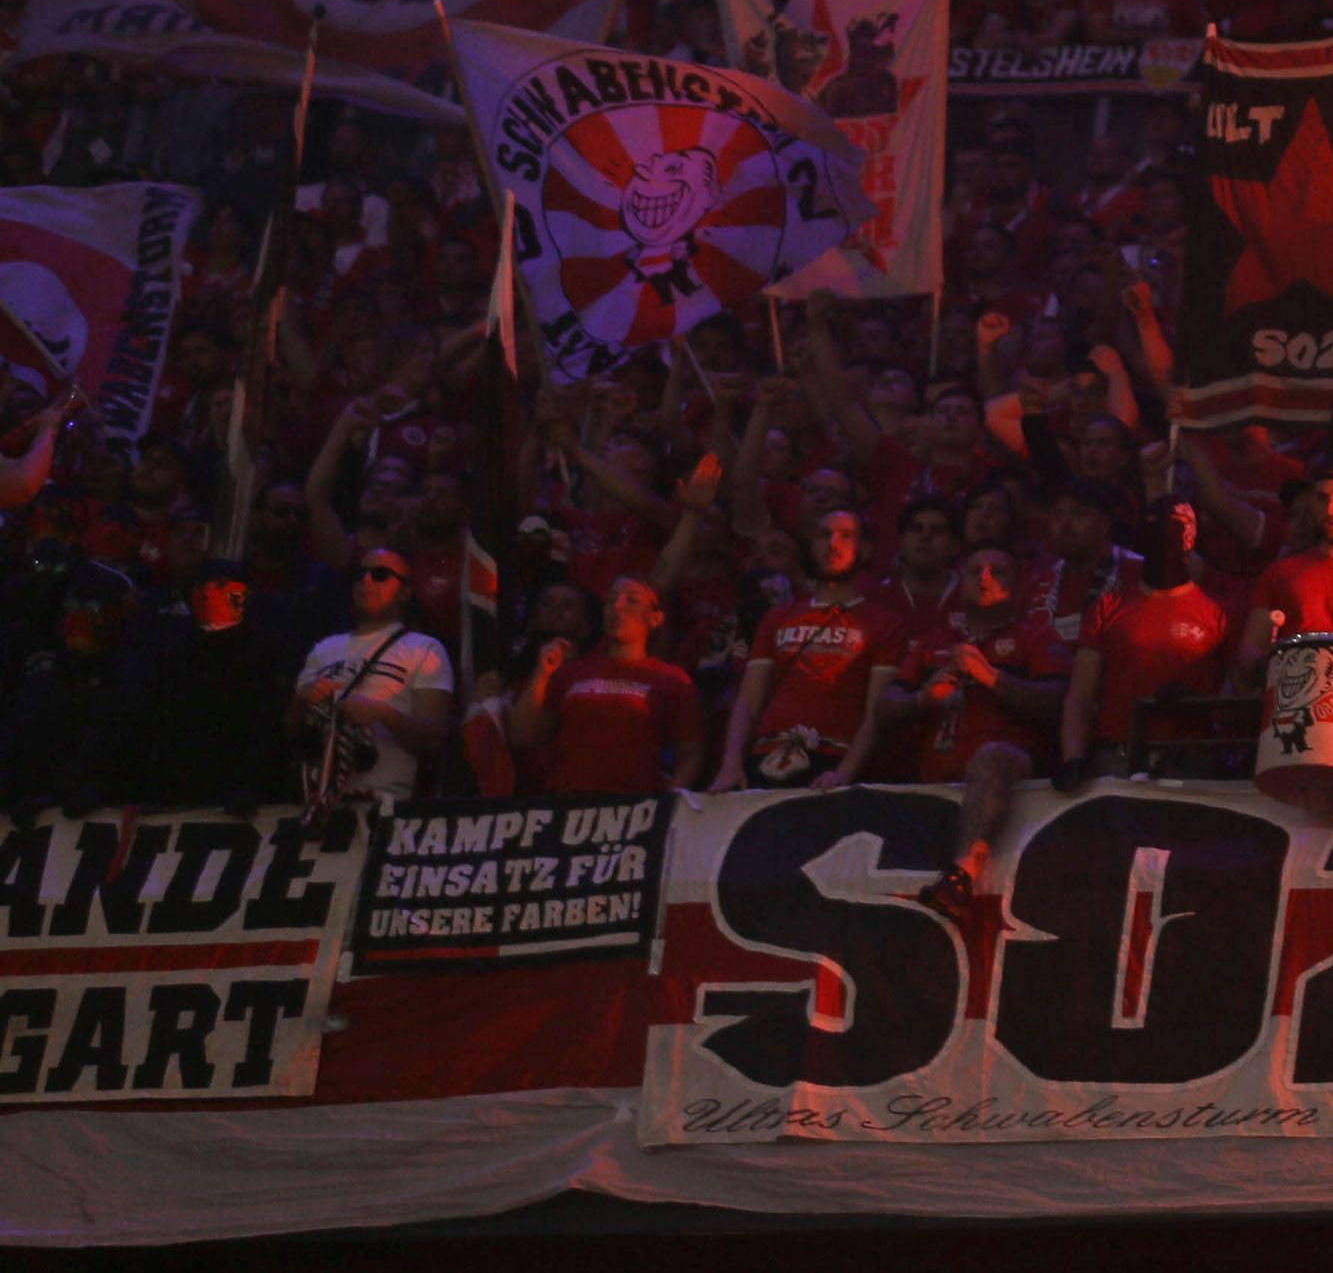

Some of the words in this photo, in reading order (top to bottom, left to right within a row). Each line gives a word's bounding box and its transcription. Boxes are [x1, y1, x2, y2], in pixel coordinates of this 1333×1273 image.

[386, 808, 554, 856] KAMPF
[561, 798, 659, 847] UND
[375, 856, 560, 899] EINSATZ
[564, 843, 648, 888] FÜR
[368, 905, 495, 938] UNSERE
[500, 890, 643, 933] FARBEN!
[682, 1096, 848, 1134] Ultras
[860, 1092, 1318, 1132] Schwabensturm
